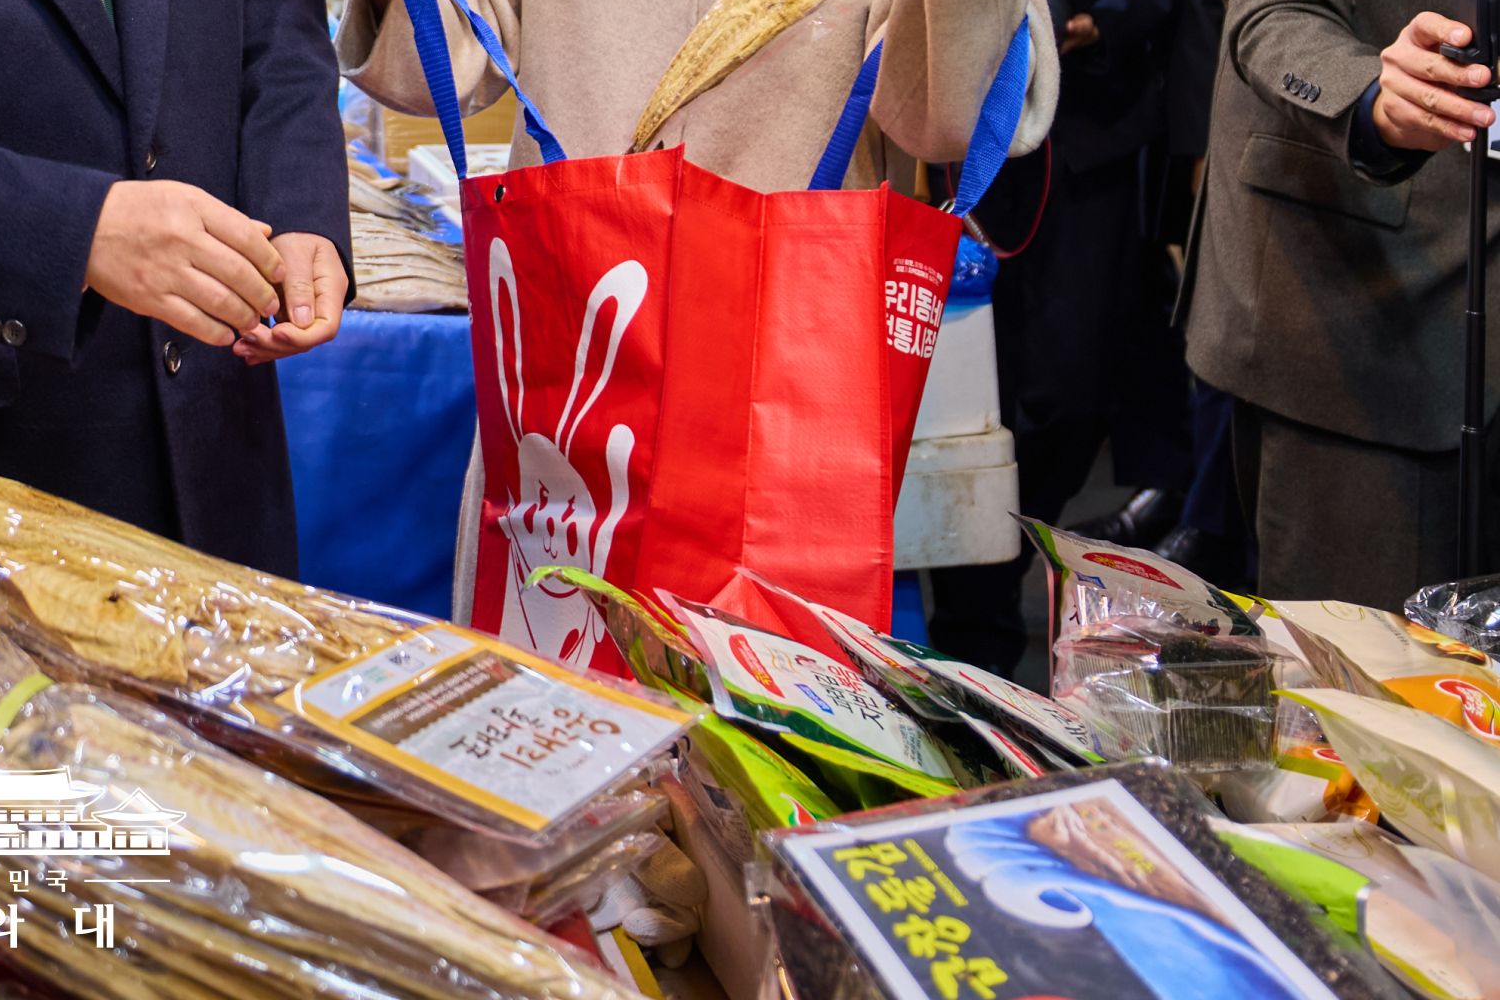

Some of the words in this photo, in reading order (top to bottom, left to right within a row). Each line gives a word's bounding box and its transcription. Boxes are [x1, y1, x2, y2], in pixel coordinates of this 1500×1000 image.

[884, 280, 944, 328] 우리동네
[495, 709, 621, 770] 용대리
[833, 841, 1009, 1000] 곱창돌김
